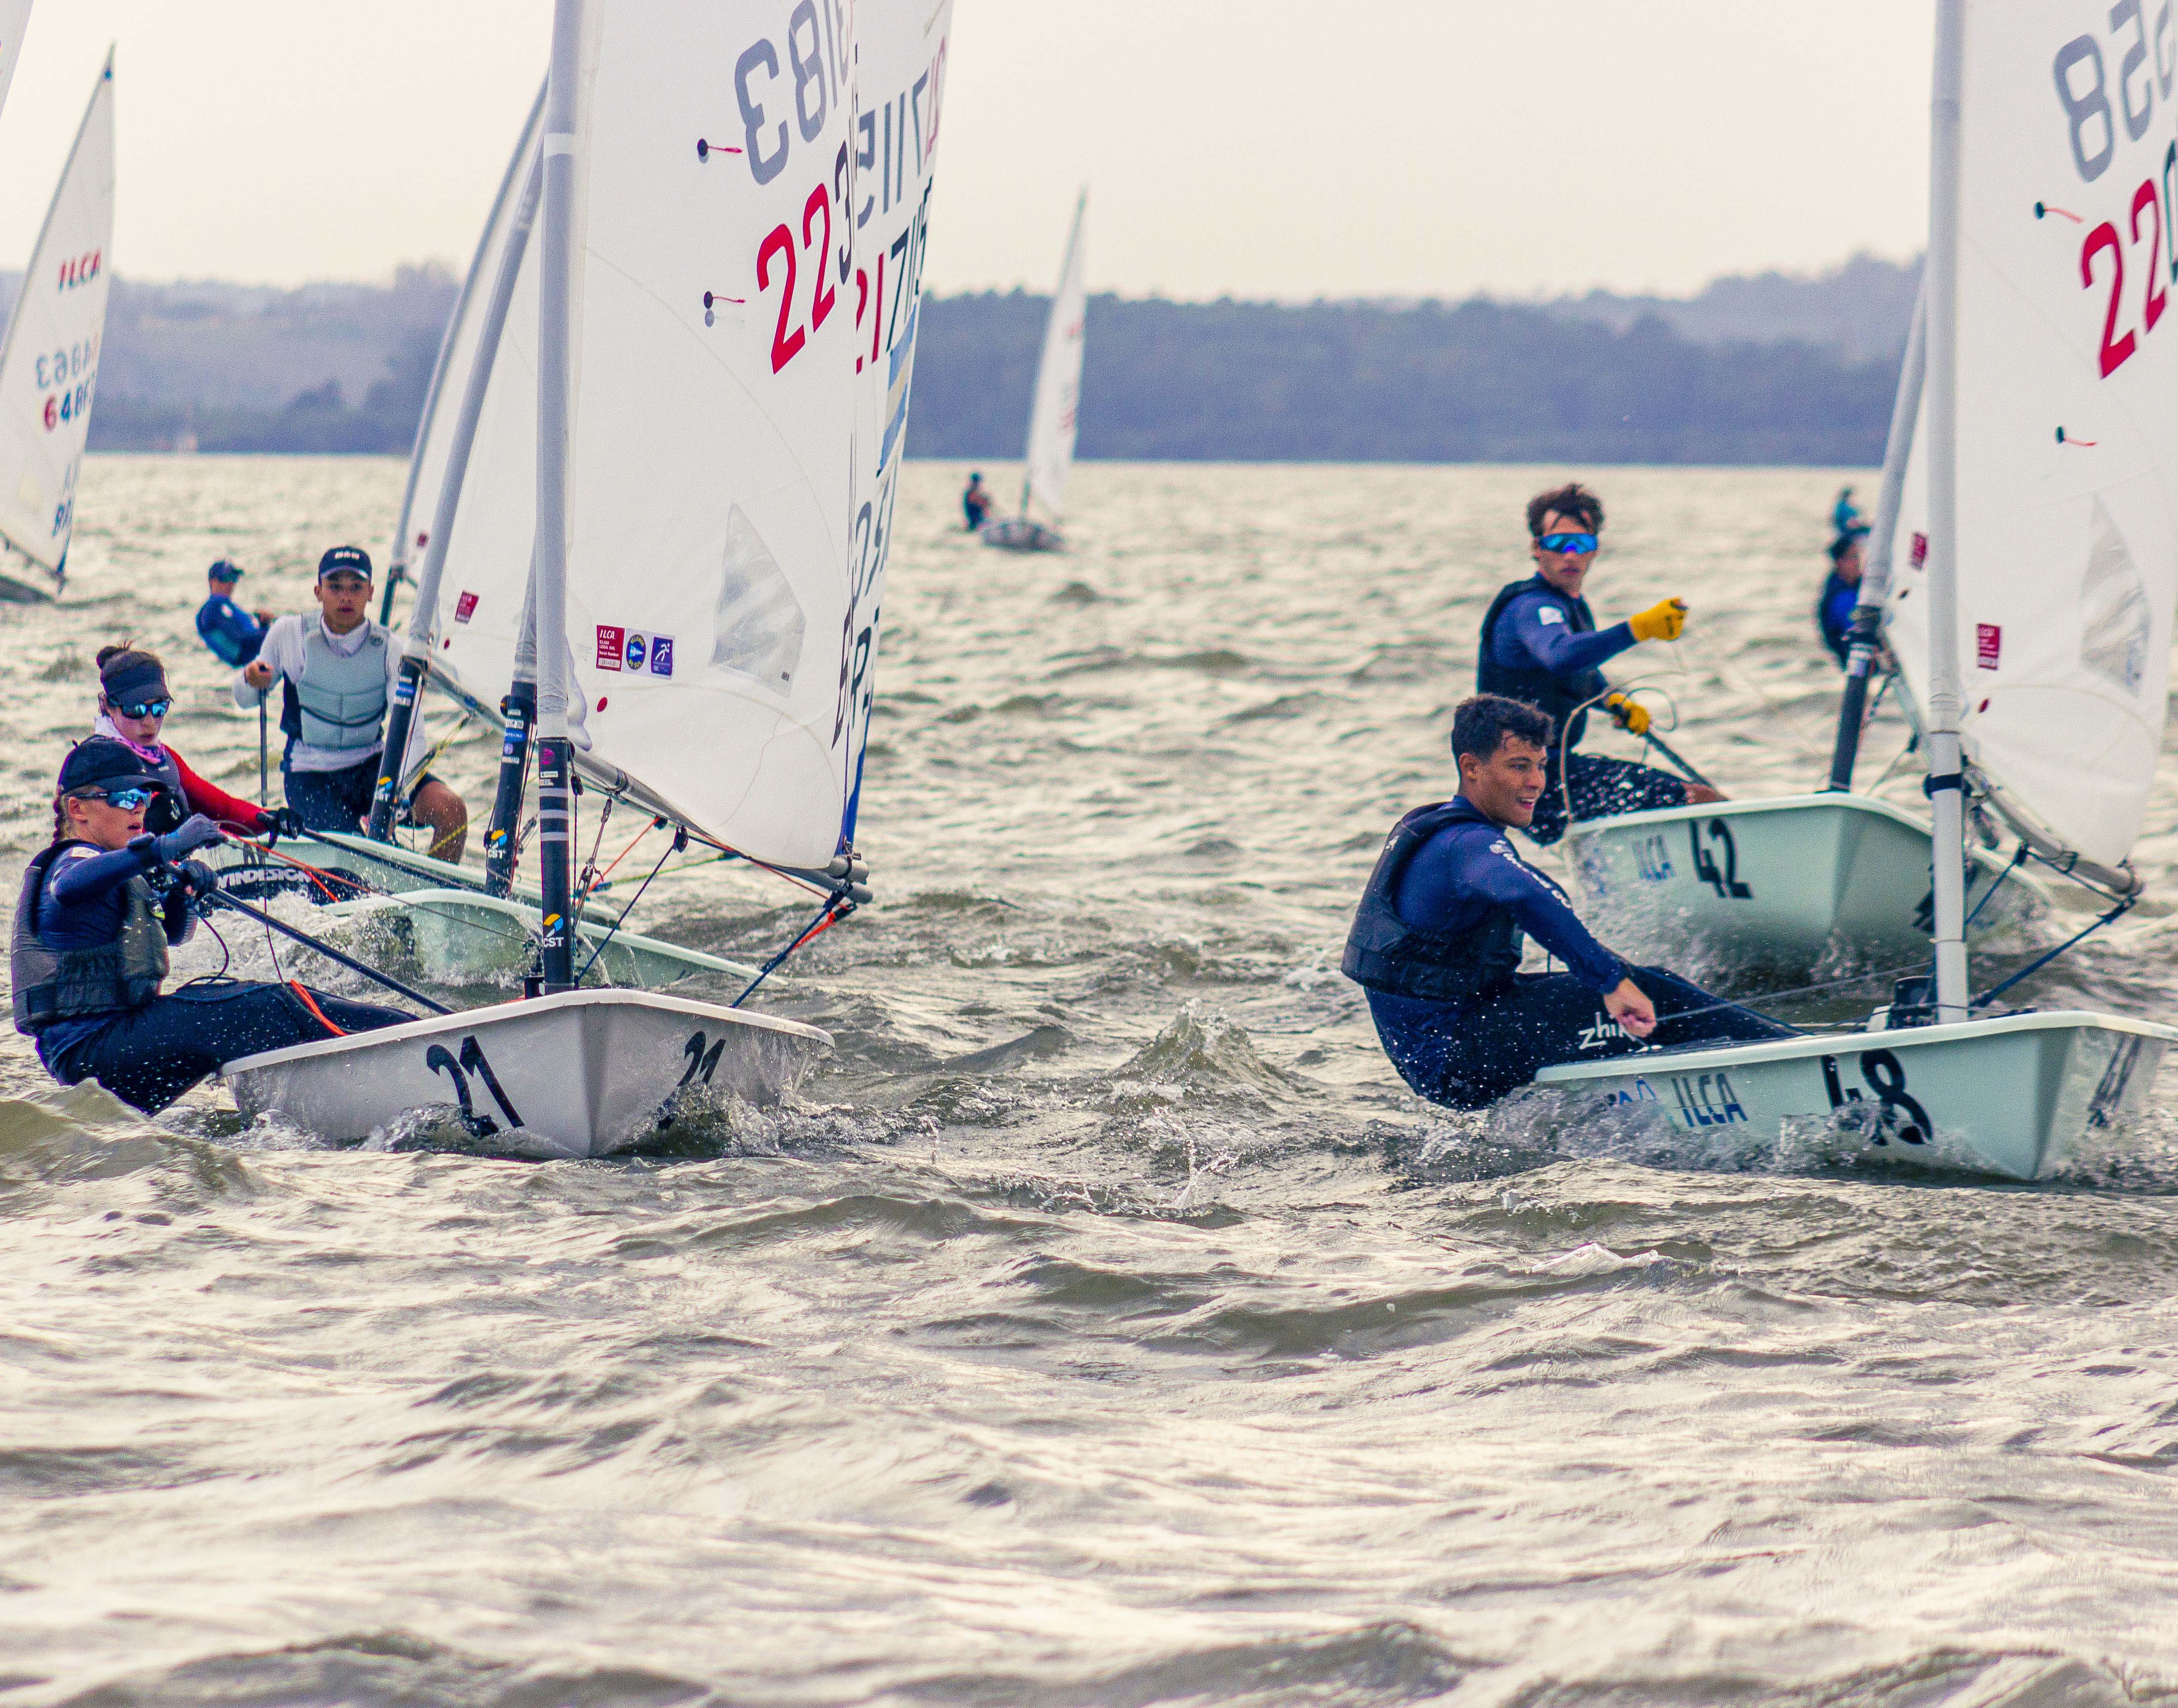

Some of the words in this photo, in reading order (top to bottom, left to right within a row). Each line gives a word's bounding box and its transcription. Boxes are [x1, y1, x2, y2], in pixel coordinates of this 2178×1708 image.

[58, 250, 101, 293] ILCA
[600, 629, 614, 640] ILCA
[1689, 817, 1752, 899] 42
[543, 937, 563, 947] CST
[426, 1035, 524, 1139] 21
[657, 1030, 726, 1130] 21
[1671, 1072, 1748, 1128] ILCA
[1820, 1049, 1933, 1147] 48
